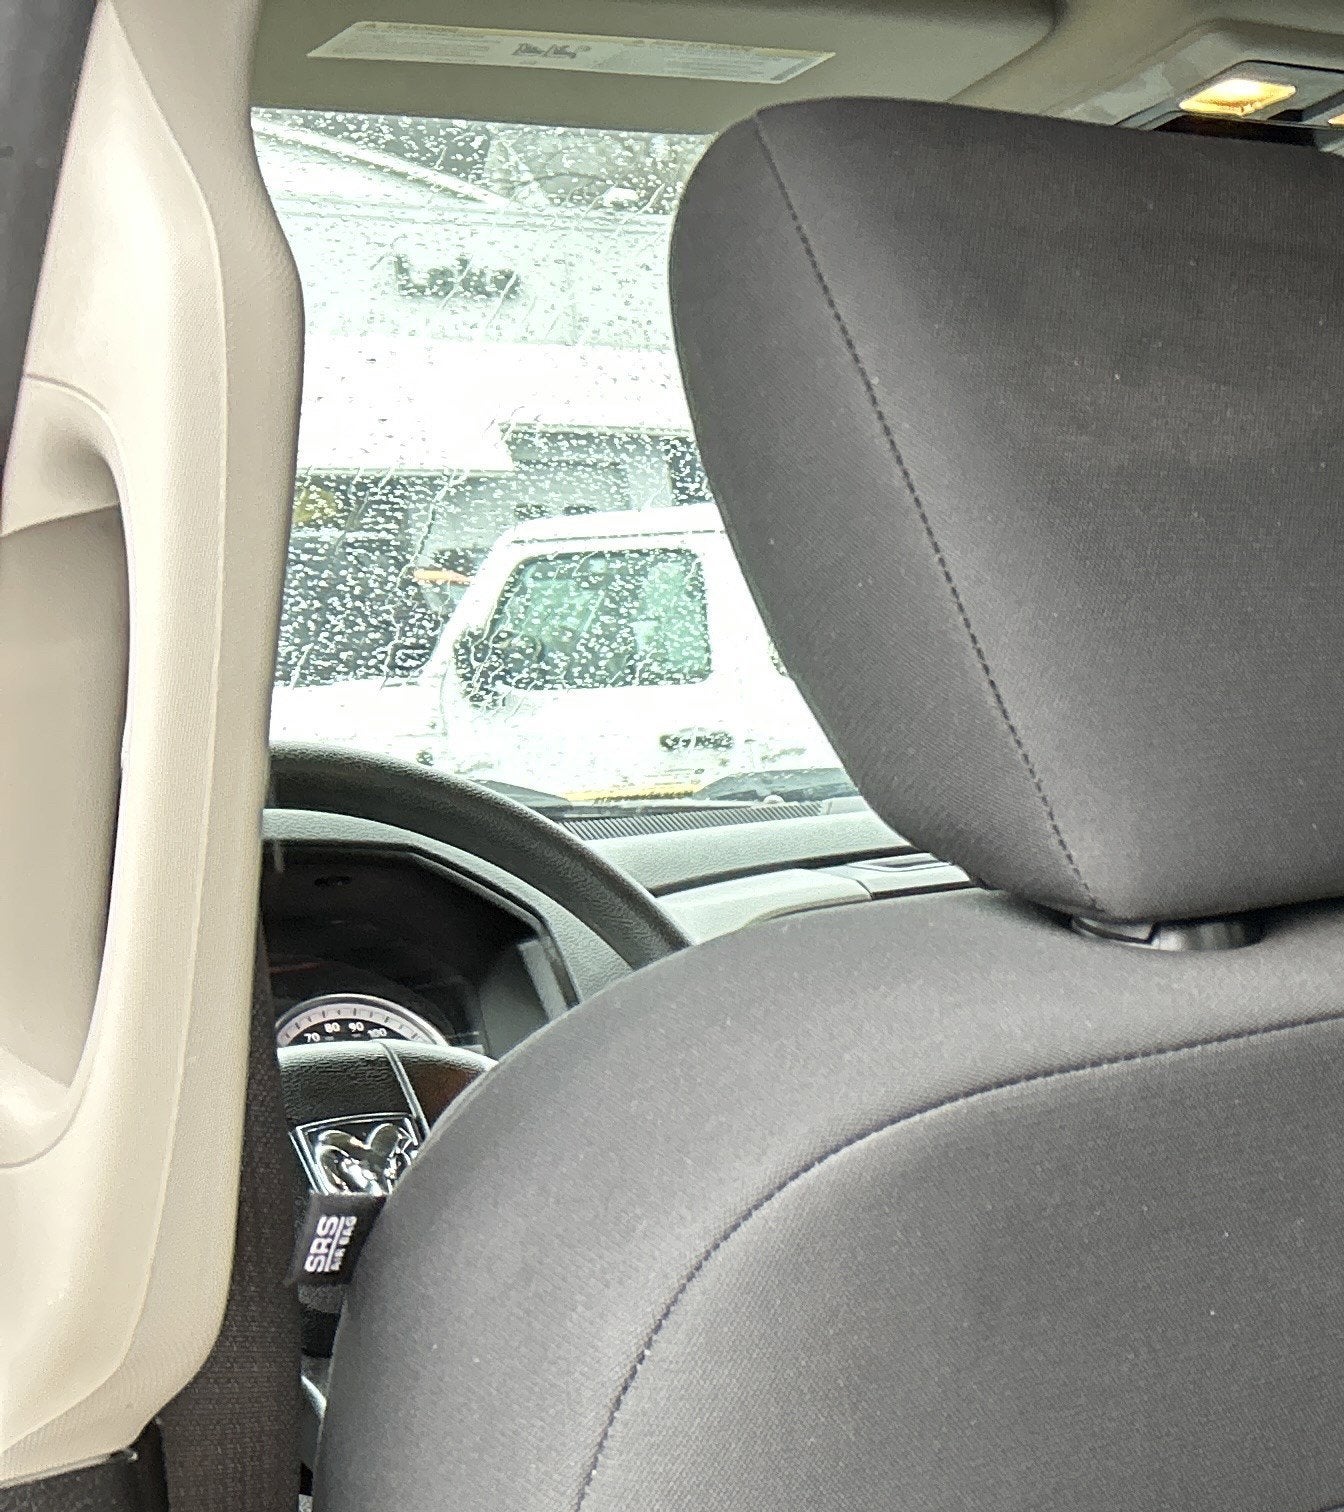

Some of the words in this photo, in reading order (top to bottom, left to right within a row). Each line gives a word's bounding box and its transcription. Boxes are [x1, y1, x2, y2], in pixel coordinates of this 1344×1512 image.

[323, 1021, 341, 1034] 80
[348, 1021, 365, 1033] 90
[303, 1032, 321, 1043] 70
[304, 1215, 339, 1272] SRS
